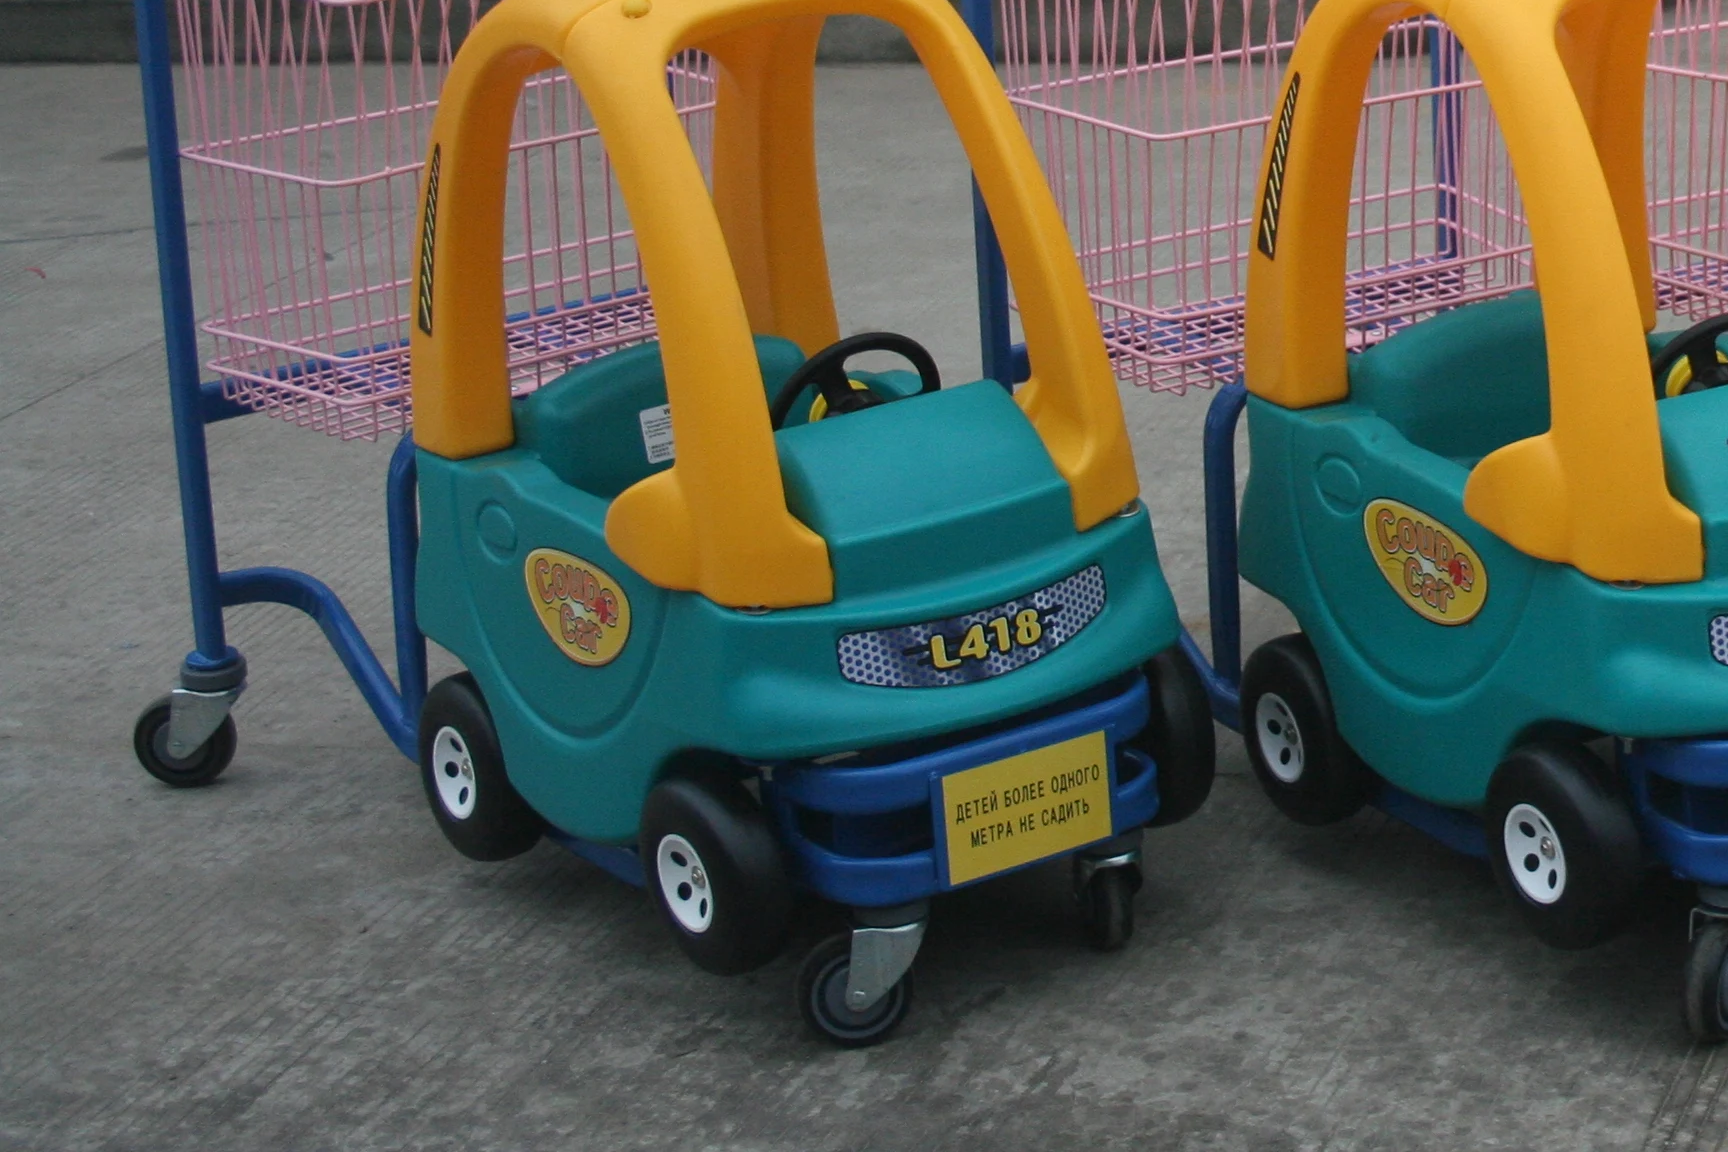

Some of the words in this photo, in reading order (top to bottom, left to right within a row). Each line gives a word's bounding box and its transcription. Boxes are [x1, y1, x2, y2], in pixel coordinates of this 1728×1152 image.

[928, 607, 1043, 671] L418
[955, 790, 999, 826] ДЕТЕЙ
[1003, 779, 1046, 808] БОЛЕЕ
[1050, 762, 1101, 794] ОДНОГО
[970, 822, 1014, 849] МЕТРА
[1018, 814, 1036, 835] НЕ
[1040, 798, 1091, 827] САДИТЬ
